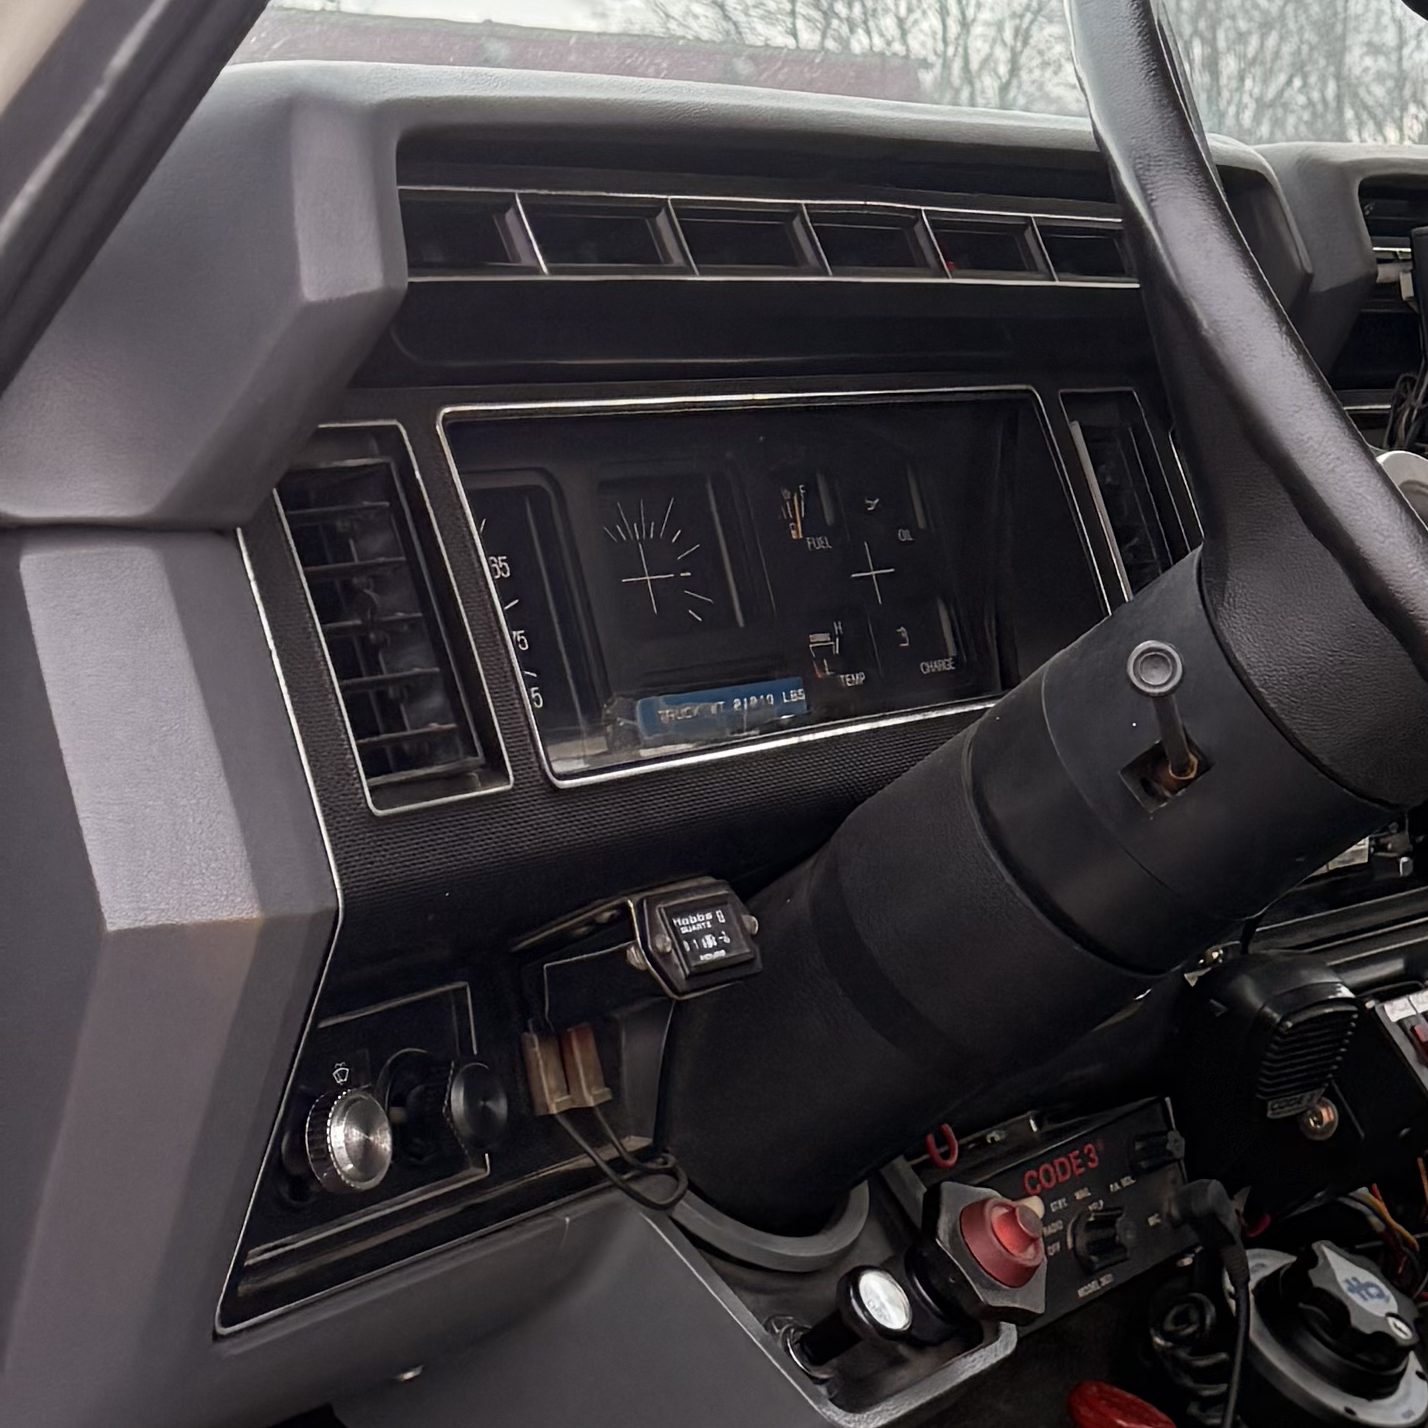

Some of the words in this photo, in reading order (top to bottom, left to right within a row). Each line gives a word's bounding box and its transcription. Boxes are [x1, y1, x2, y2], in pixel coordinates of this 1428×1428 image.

[897, 529, 915, 542] OIL
[805, 536, 832, 551] FUEL
[919, 658, 956, 675] CHARGE
[839, 672, 866, 688] TEMP
[530, 687, 544, 709] 5
[782, 688, 806, 703] LBS
[672, 912, 713, 927] Hobbs
[1024, 1149, 1085, 1196] CODE
[1083, 1143, 1099, 1169] 3
